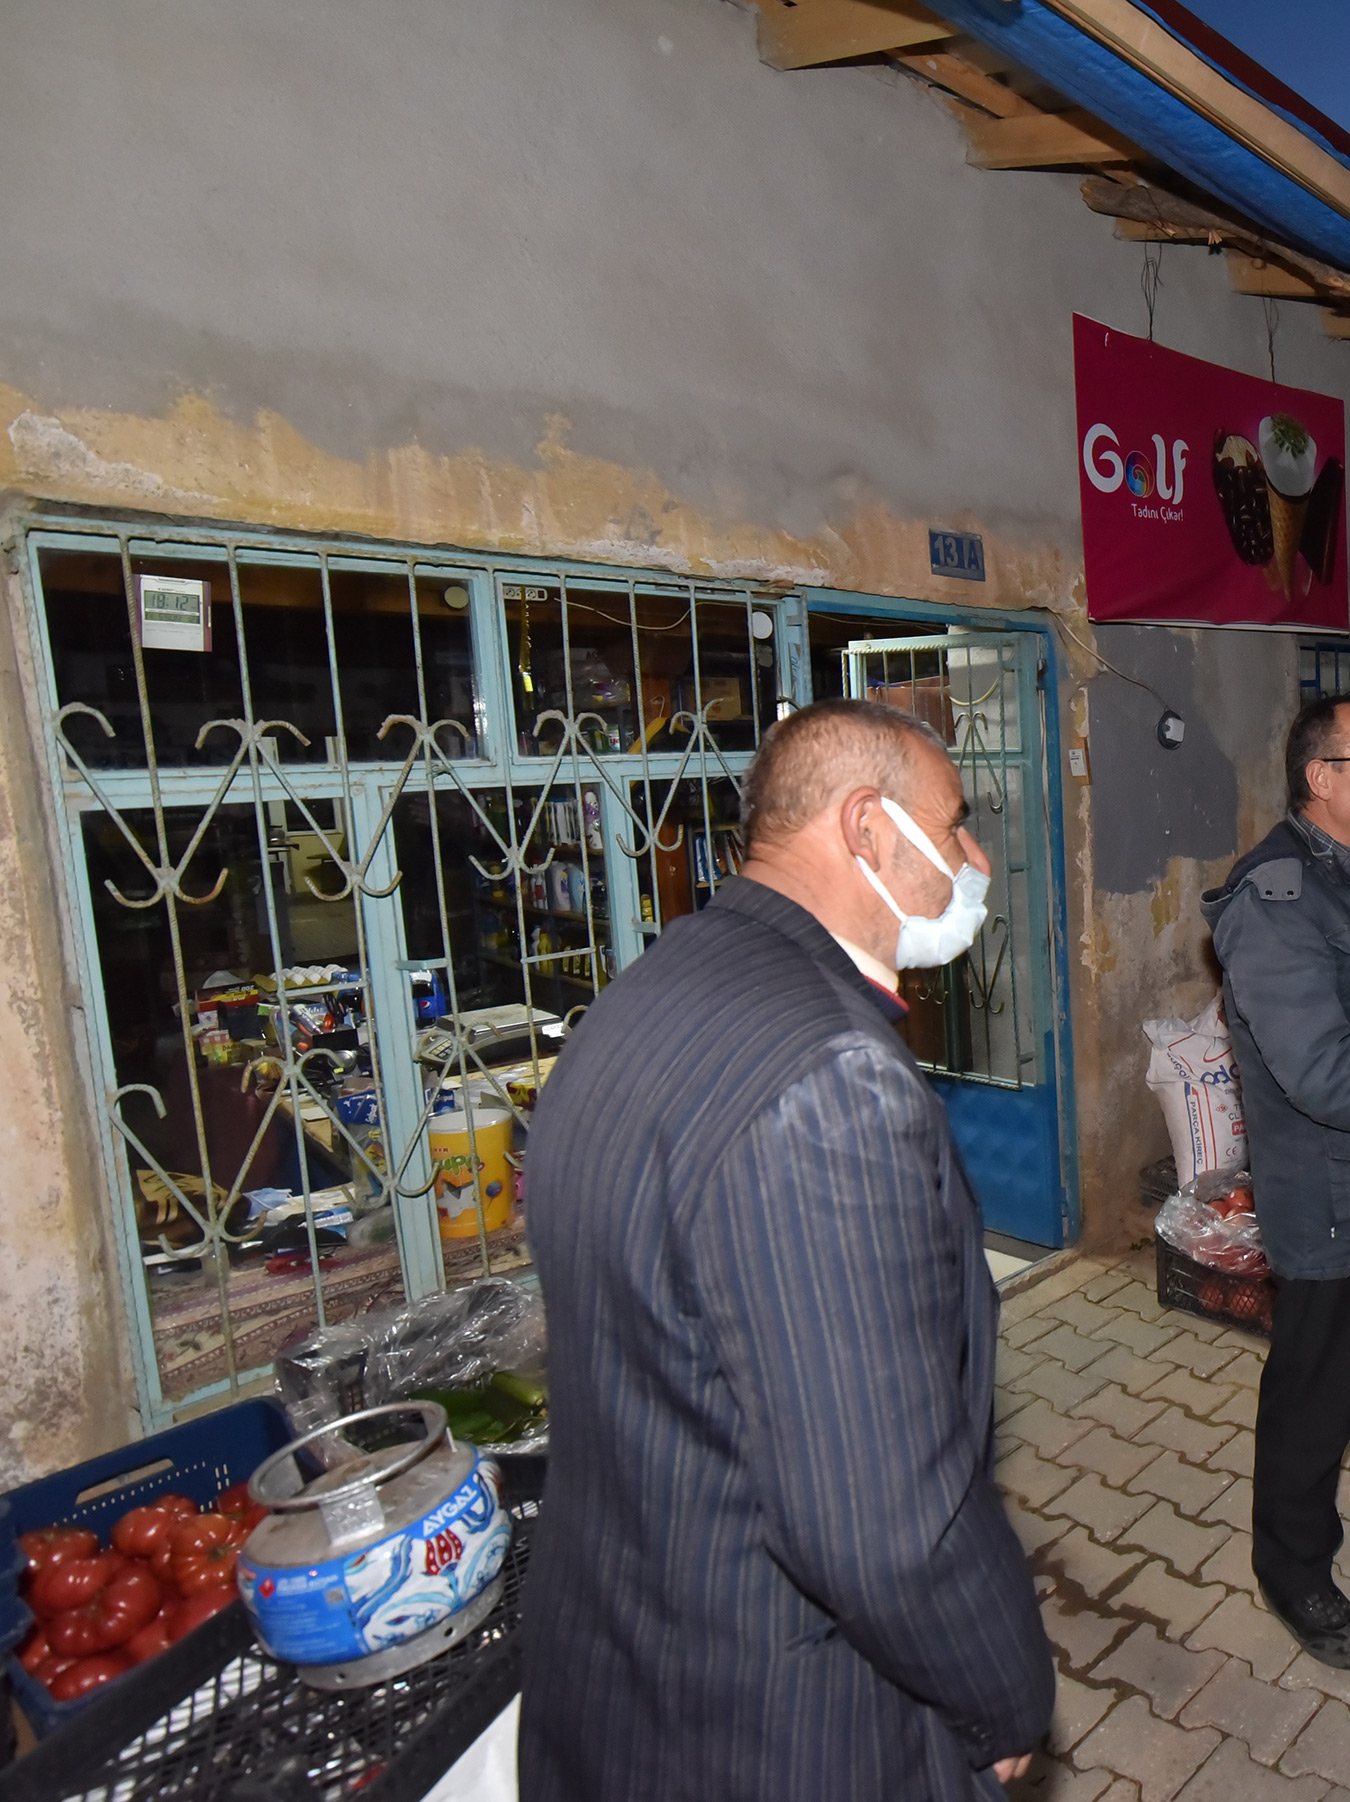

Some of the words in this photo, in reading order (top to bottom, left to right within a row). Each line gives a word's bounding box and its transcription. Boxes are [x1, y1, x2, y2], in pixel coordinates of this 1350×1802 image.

[1083, 423, 1189, 505] Golf
[1131, 503, 1159, 520] Tadını
[1160, 506, 1184, 524] Çıkar!
[1190, 1101, 1200, 1134] PARÇA
[421, 1485, 480, 1537] AYGAZ
